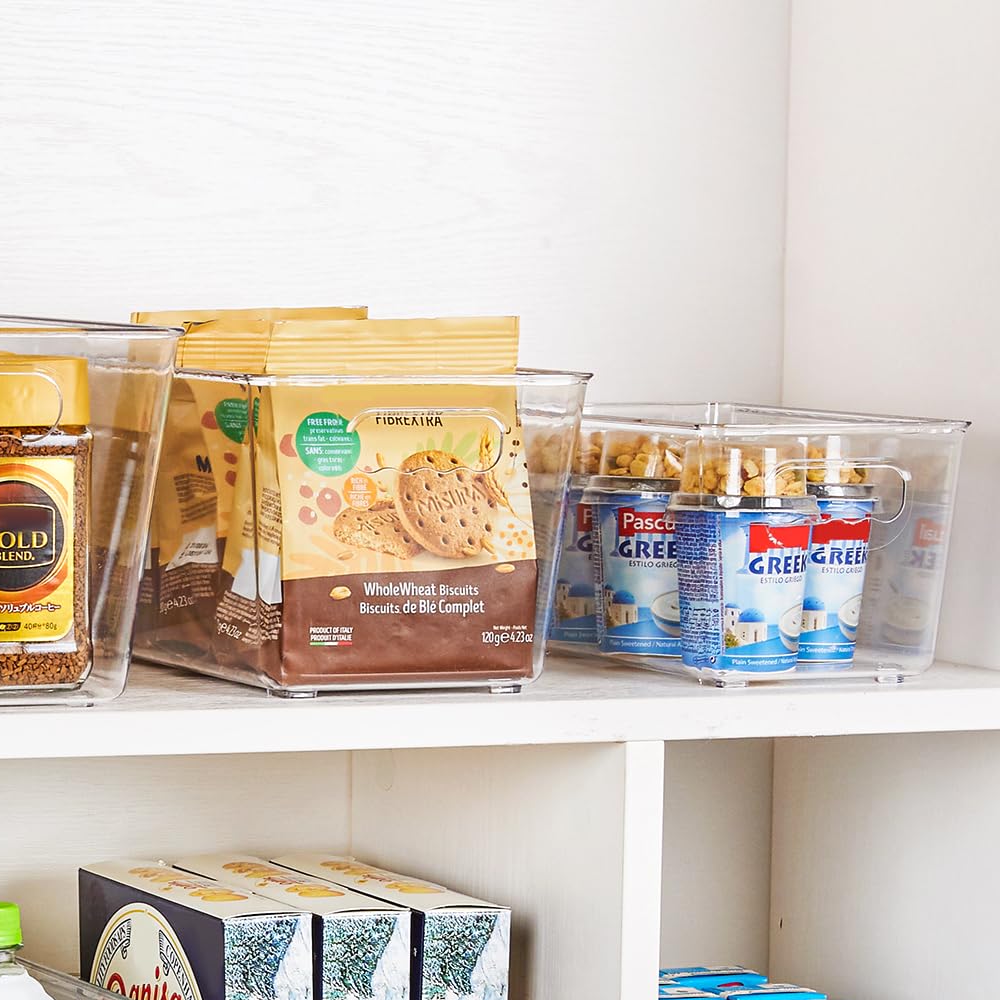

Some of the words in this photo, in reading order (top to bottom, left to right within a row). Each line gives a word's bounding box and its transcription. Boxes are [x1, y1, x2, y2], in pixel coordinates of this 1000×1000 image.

[623, 512, 676, 531] Pascu
[618, 540, 677, 559] GREE
[811, 547, 868, 565] GREEK
[628, 560, 654, 569] ESTILO
[749, 553, 808, 575] GREEK
[821, 566, 845, 574] ESTILO
[760, 576, 784, 584] ESTILO
[363, 582, 436, 597] WholeWheat
[439, 584, 479, 596] Biscuits
[359, 602, 400, 615] Biscuits
[402, 600, 417, 614] de
[419, 599, 436, 613] Blé
[438, 599, 485, 617] Complet
